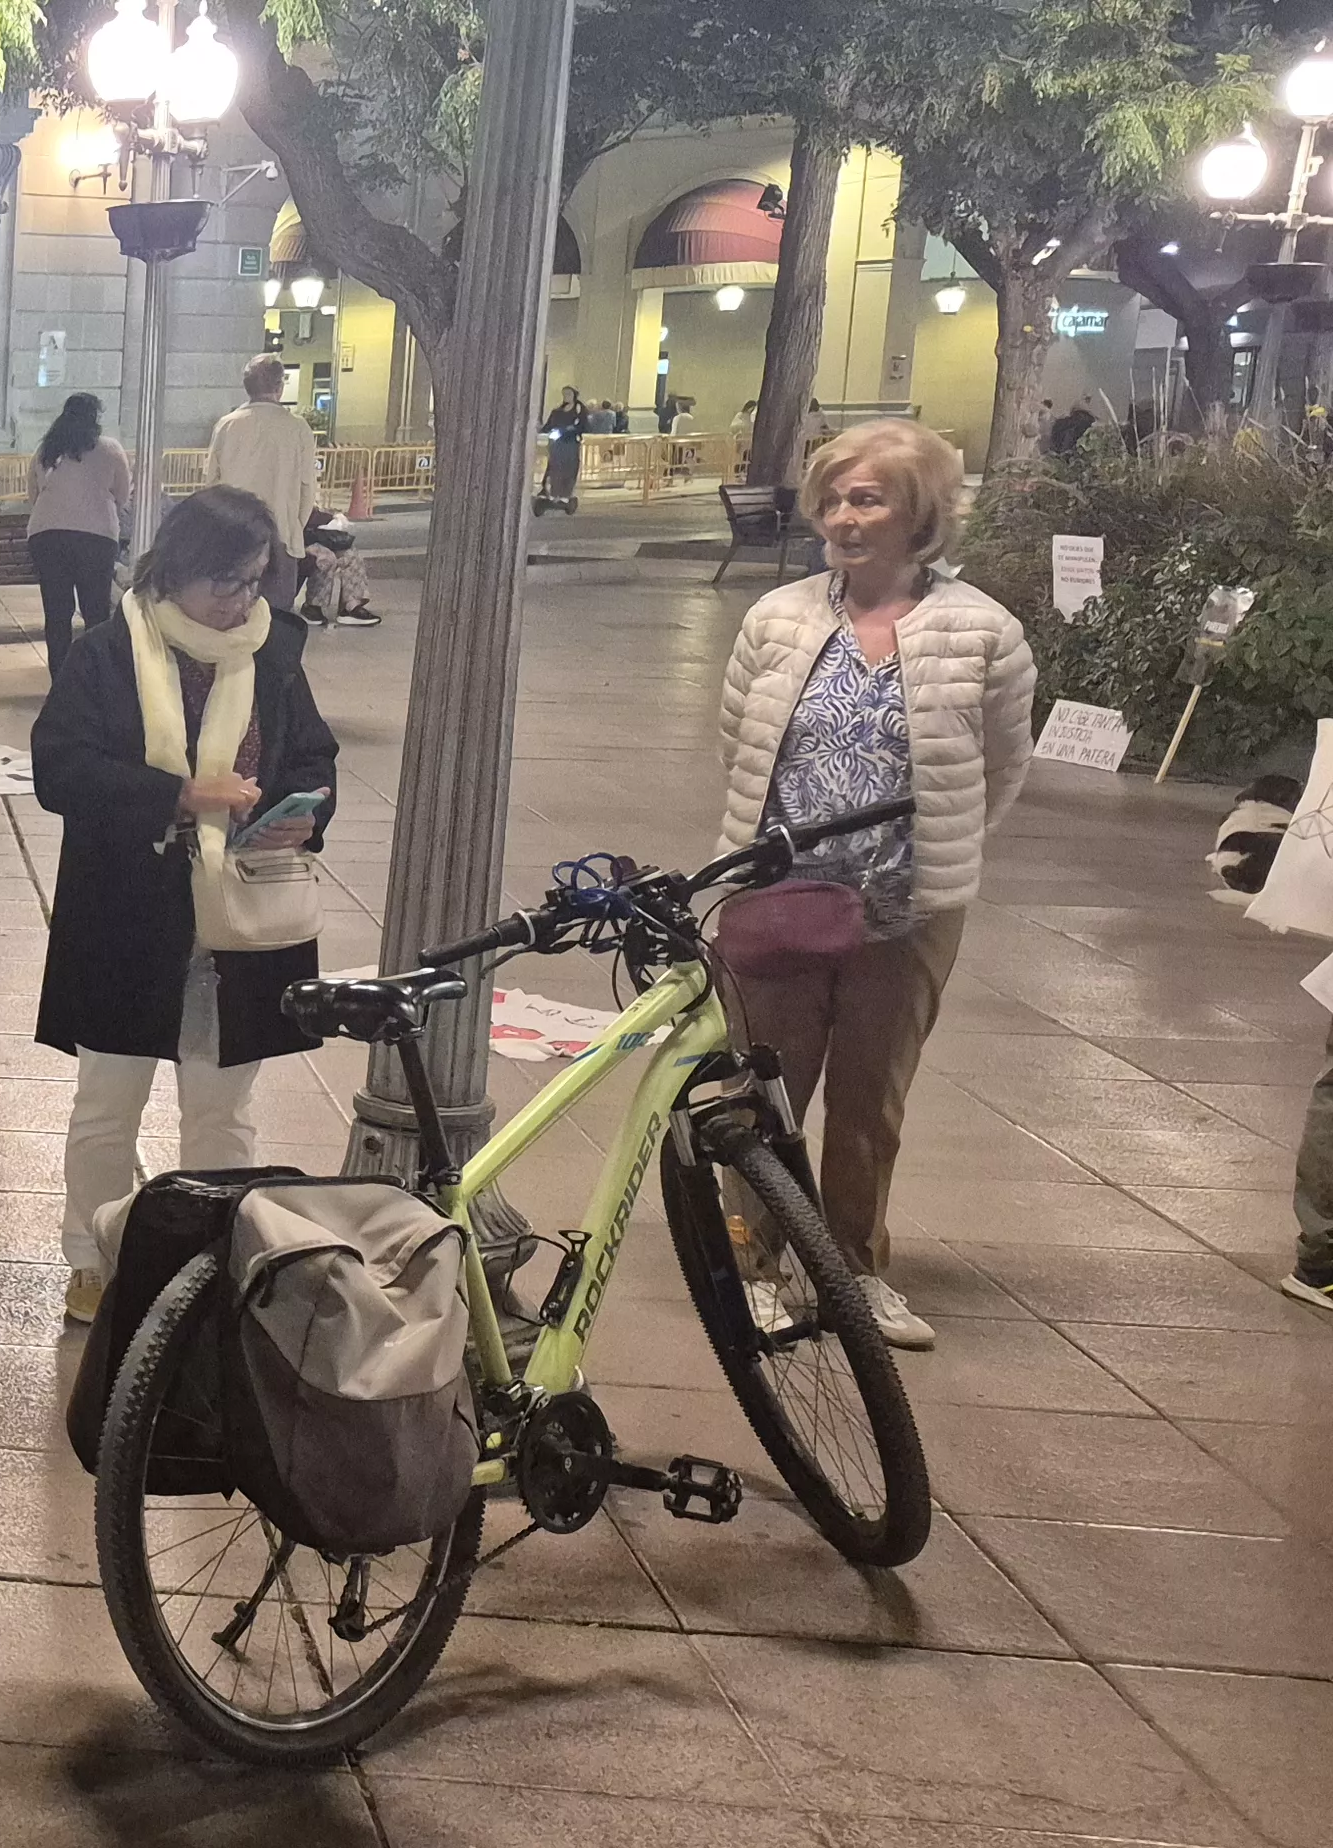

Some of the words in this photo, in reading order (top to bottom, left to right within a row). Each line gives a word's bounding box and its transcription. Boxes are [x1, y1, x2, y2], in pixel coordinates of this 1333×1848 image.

[1063, 314, 1109, 334] cajamar
[1040, 741, 1055, 755] EN
[1056, 743, 1075, 757] UNA
[1079, 747, 1117, 767] PATERA
[573, 1111, 662, 1345] ROCKRIDER
